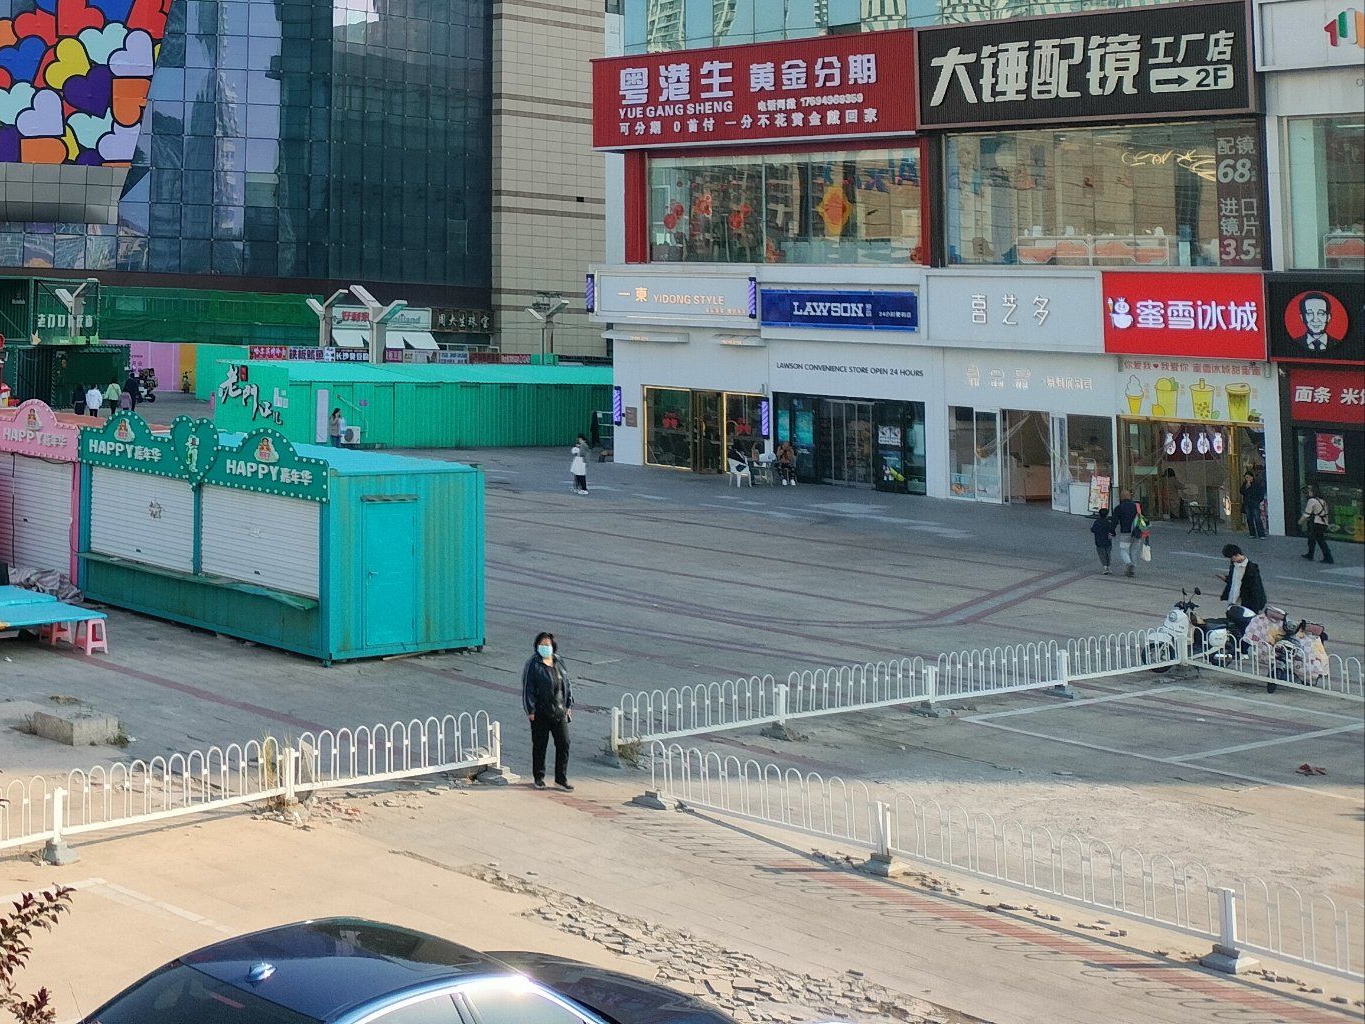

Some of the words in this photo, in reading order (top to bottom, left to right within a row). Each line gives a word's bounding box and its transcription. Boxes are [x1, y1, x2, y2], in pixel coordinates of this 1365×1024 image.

[930, 33, 1141, 107] 大锤配镜
[1149, 30, 1234, 64] 工厂店
[1195, 67, 1228, 89] 2F
[619, 60, 734, 105] 粤港生
[749, 53, 877, 93] 黄金分期
[619, 108, 644, 119] YUE
[646, 105, 684, 117] GANG
[687, 101, 733, 115] SHENG
[619, 121, 662, 136] 可分期
[1217, 135, 1256, 155] 配镜
[1220, 197, 1258, 216] 进口
[1220, 217, 1259, 236] 镜片
[653, 293, 691, 305] YIDONG
[693, 294, 725, 306] STYLE
[792, 301, 864, 317] LAWSON
[971, 293, 1050, 326] 喜艺多
[1136, 299, 1259, 332] 蜜雪冰城
[438, 314, 490, 329] 周大生珠宝
[777, 362, 803, 370] LAWSON
[804, 363, 847, 373] CONVENIENCE
[848, 365, 869, 374] STORE
[870, 367, 888, 375] OPEN
[900, 368, 924, 377] HOURS
[1294, 386, 1331, 403] 面条
